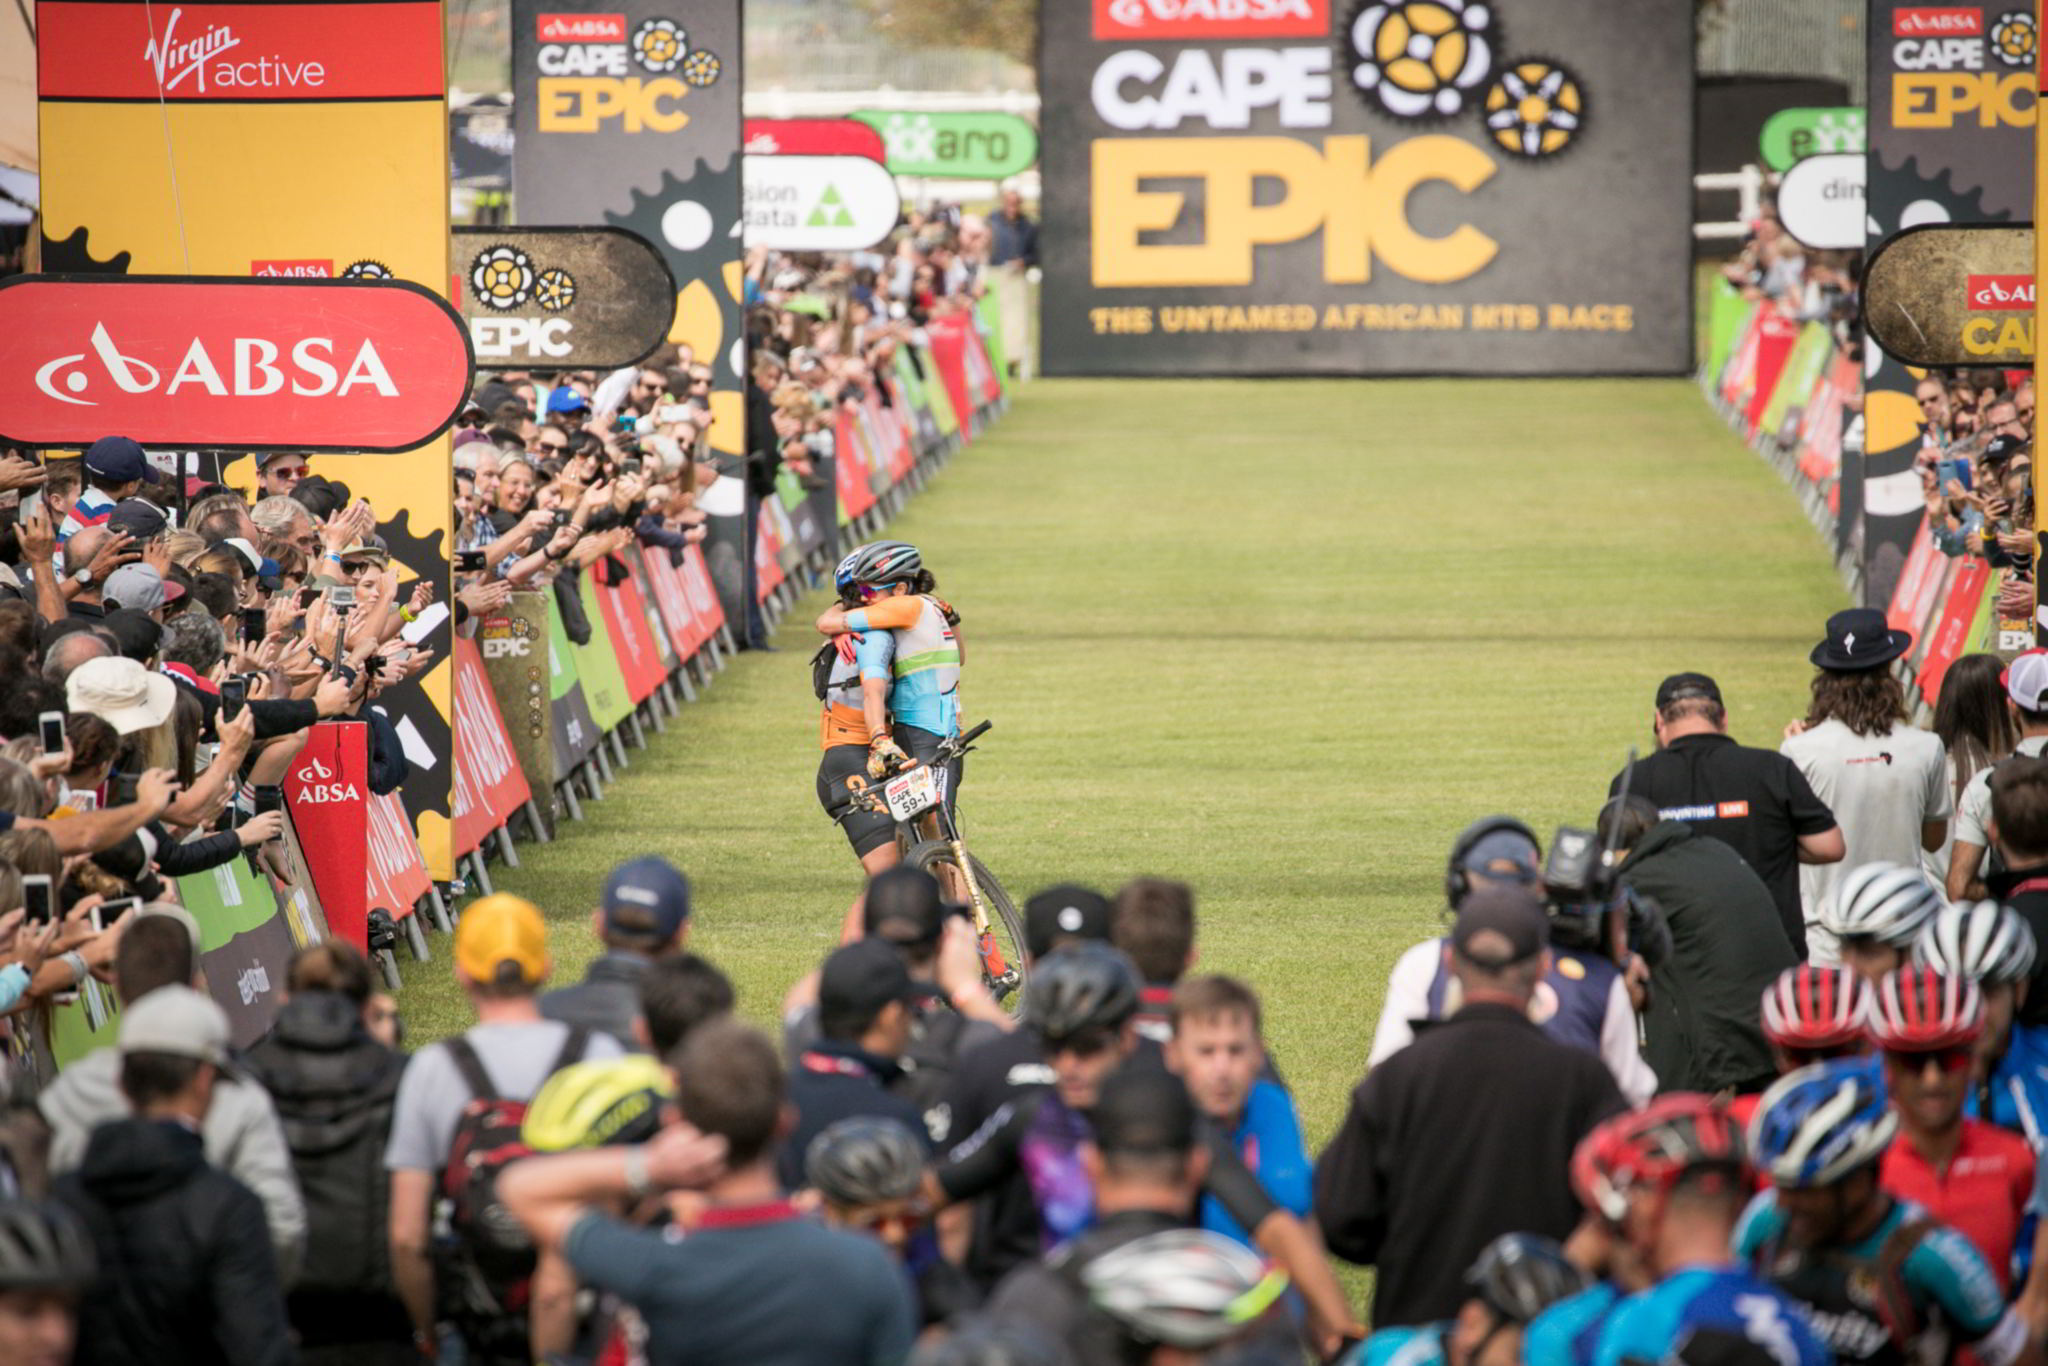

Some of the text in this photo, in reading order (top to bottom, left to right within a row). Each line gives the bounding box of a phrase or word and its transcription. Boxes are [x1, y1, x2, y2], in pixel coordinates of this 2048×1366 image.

[571, 20, 620, 36] ABSA
[1930, 14, 1976, 30] ABSA
[144, 8, 240, 93] Virgin
[537, 44, 628, 76] CAPE
[1893, 39, 1984, 70] CAPE
[215, 55, 325, 86] active
[1091, 47, 1332, 129] CAPE
[1892, 72, 2037, 128] EPIC
[538, 77, 690, 133] EPIC
[1091, 134, 1500, 288] EPIC
[284, 265, 329, 278] ABSA
[1089, 303, 1634, 334] THE UNTAMED AFRICAN MTB RACE
[471, 317, 574, 357] EPIC
[1963, 317, 2036, 356] CA
[165, 336, 400, 397] ABSA
[483, 638, 531, 658] EPIC
[296, 782, 360, 804] ABSA
[890, 788, 912, 805] CAPE
[902, 791, 928, 814] 59-1
